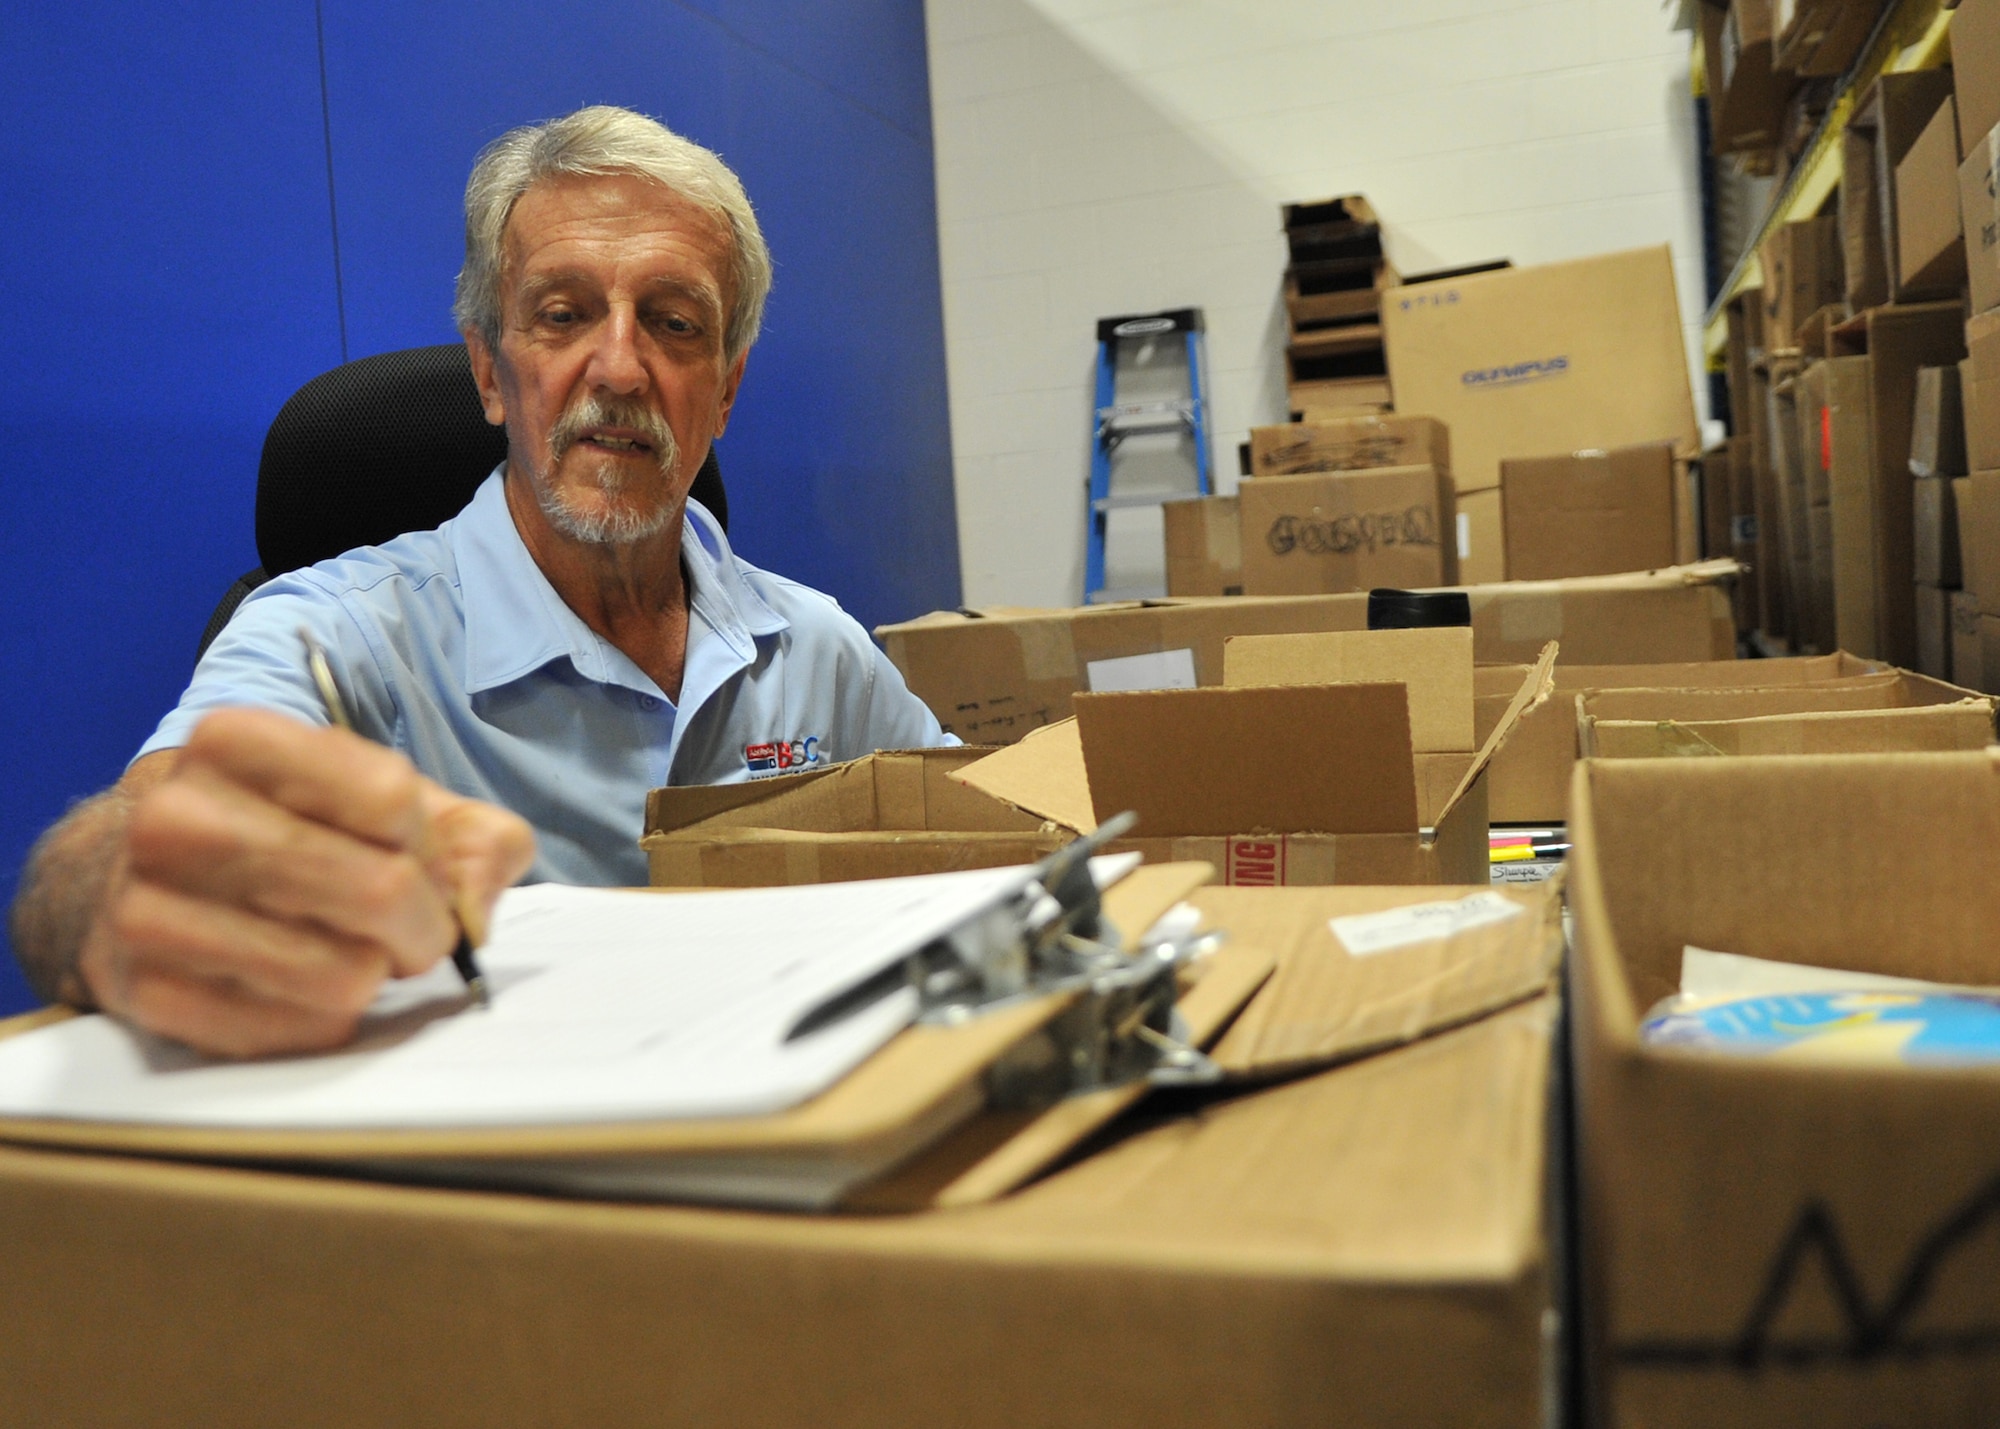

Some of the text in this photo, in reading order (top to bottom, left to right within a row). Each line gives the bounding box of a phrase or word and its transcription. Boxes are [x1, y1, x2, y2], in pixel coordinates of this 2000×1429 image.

[1461, 355, 1569, 384] OLYMPUS
[776, 735, 819, 769] BSC
[1491, 865, 1540, 879] Sharpie
